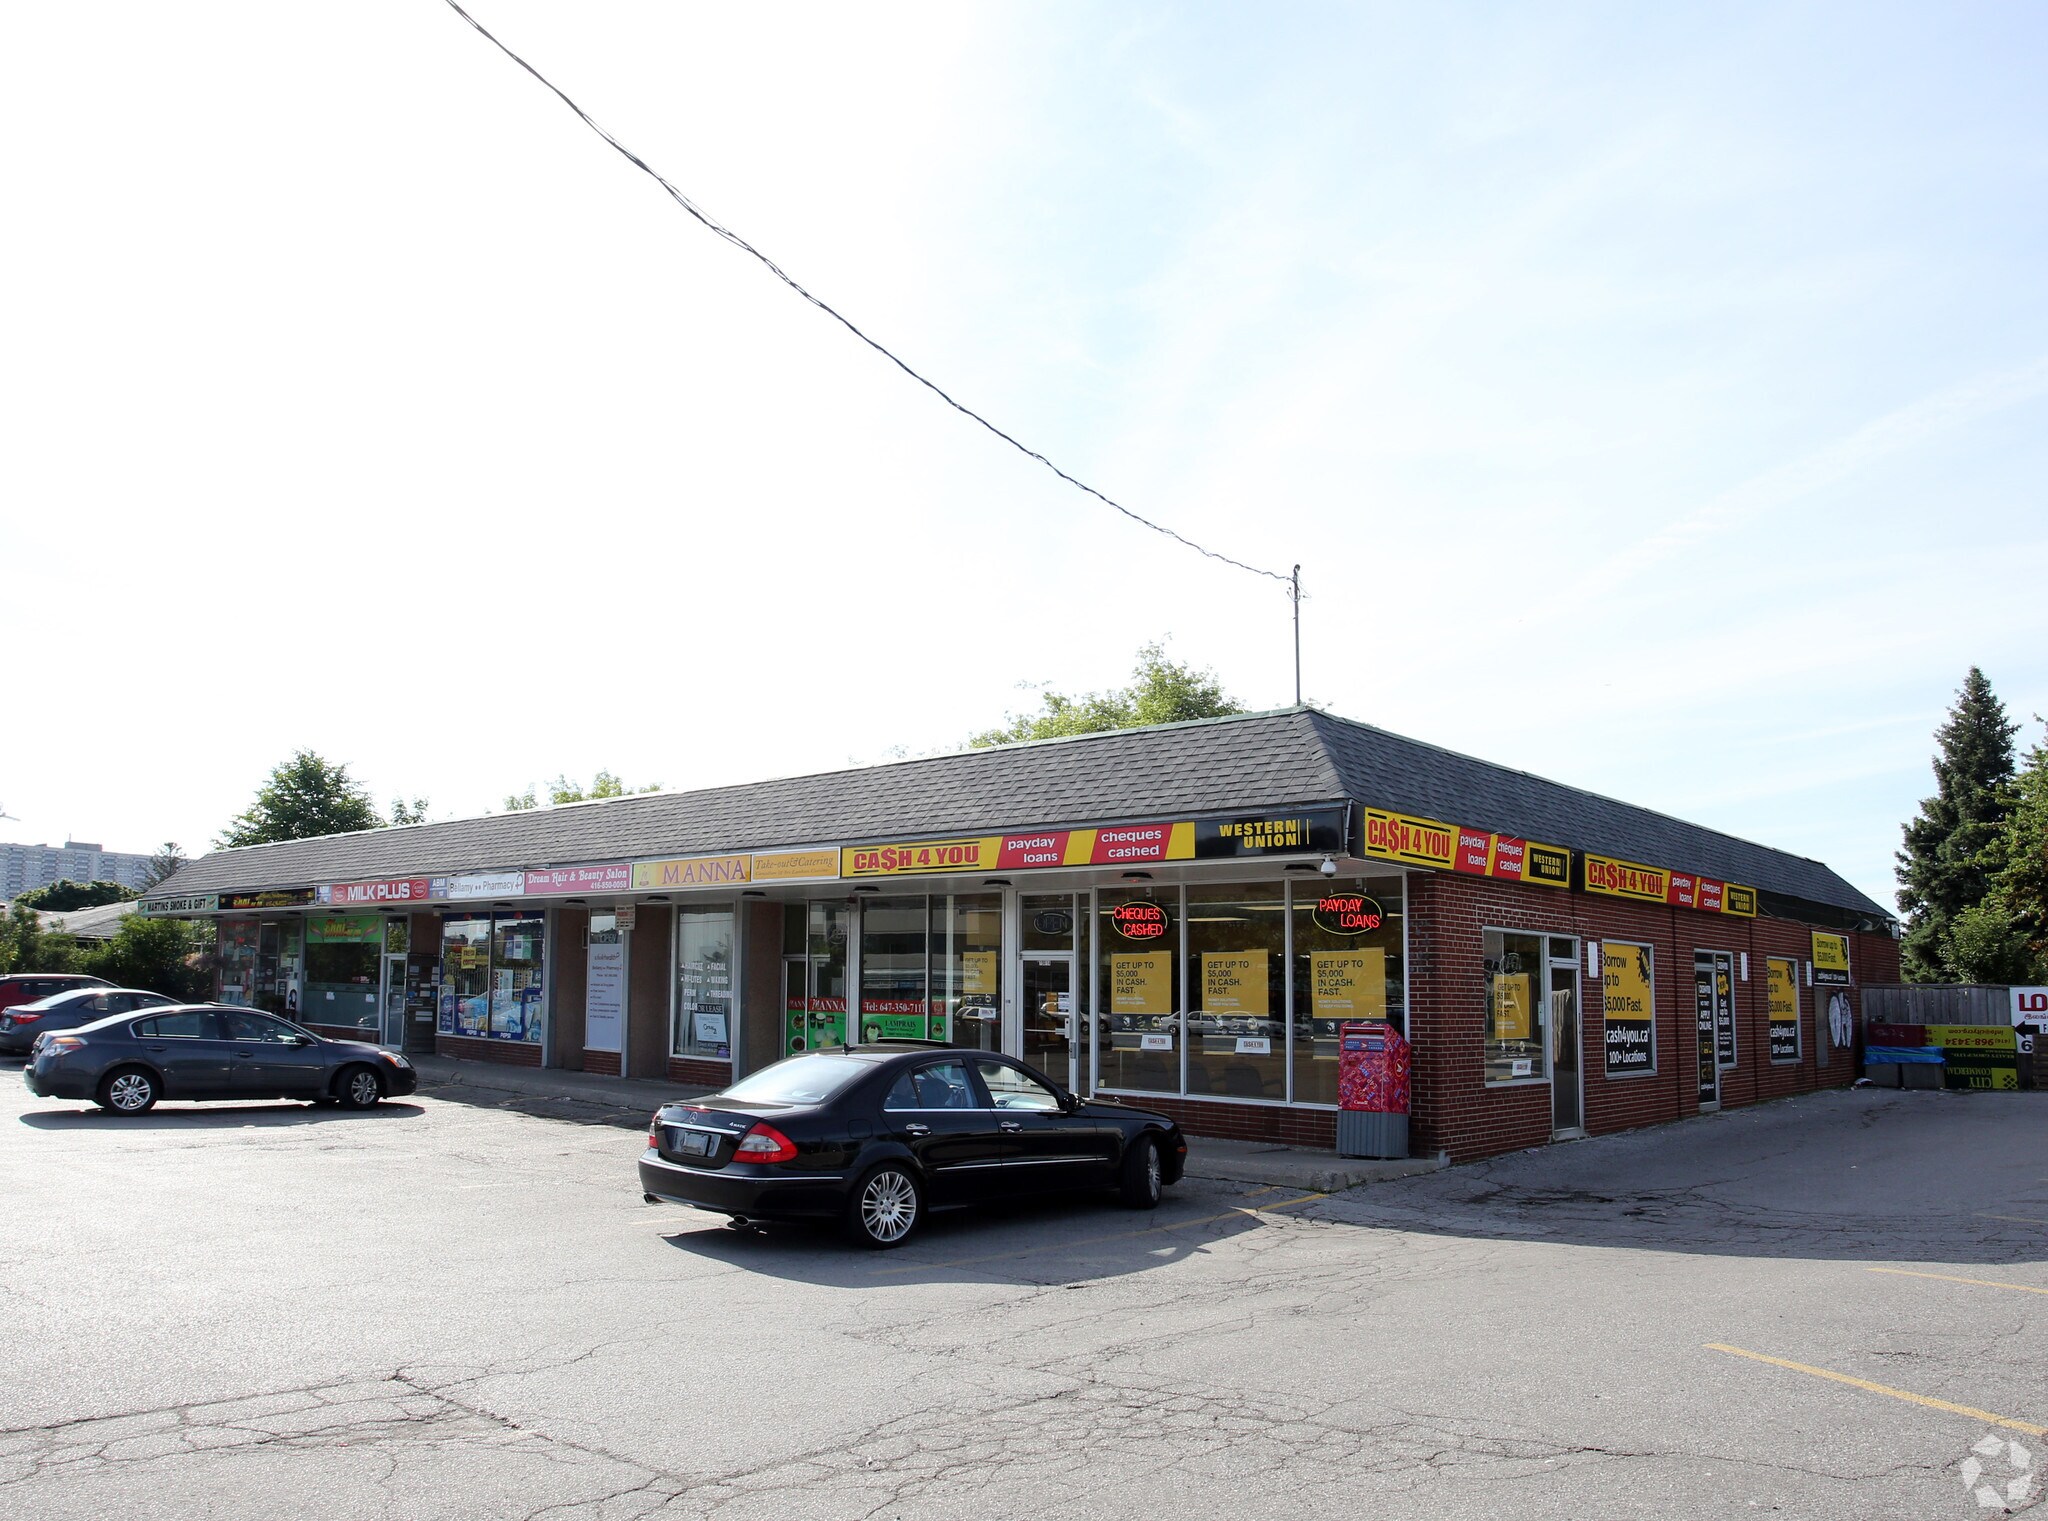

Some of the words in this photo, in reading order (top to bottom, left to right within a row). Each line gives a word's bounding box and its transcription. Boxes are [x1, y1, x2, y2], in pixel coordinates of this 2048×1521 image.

[1219, 819, 1297, 837] WESTERN
[1101, 829, 1162, 843] cheques
[1243, 833, 1297, 849] UNION
[1368, 818, 1410, 853] CA$H
[1412, 828, 1422, 852] 4
[1424, 830, 1450, 858] YOU
[1459, 835, 1485, 850] payday
[1008, 837, 1056, 850] payday
[1497, 841, 1523, 856] cheques
[1023, 851, 1058, 863] loans
[1107, 844, 1160, 858] cashed
[853, 847, 913, 871] CA$H
[916, 848, 931, 866] 4
[935, 845, 979, 864] YOU
[1467, 853, 1487, 867] loans
[1532, 853, 1561, 866] WESTERN
[662, 859, 746, 884] MANNA
[1499, 859, 1522, 873] cashed
[1541, 864, 1561, 876] UNION
[432, 878, 446, 888] ABM
[528, 873, 549, 884] Dream
[551, 871, 568, 887] Hair
[569, 871, 576, 881] &
[578, 869, 604, 882] Beauty
[605, 868, 627, 880] Salon
[1588, 863, 1626, 890] CA$H
[1629, 871, 1637, 890] 4
[1640, 873, 1663, 895] YOU
[1672, 876, 1692, 889] payday
[347, 884, 377, 901] MILK
[377, 882, 410, 900] PLUS
[450, 881, 474, 894] Bellamy
[482, 878, 515, 892] Pharmacy
[1701, 881, 1721, 895] cheques
[1679, 892, 1693, 904] loans
[1703, 897, 1720, 909] cashed
[147, 900, 169, 912] MARTINS
[170, 899, 187, 911] SMOKE
[188, 899, 193, 910] &
[194, 898, 207, 910] GIFT
[1319, 898, 1363, 912] PAYDAY
[1114, 906, 1160, 921] CHEQUES
[1036, 916, 1068, 931] OPEN
[1340, 914, 1380, 929] LOANS
[1123, 923, 1163, 936] CASHED
[710, 962, 727, 971] FACIAL
[1132, 961, 1142, 969] UP
[1144, 961, 1154, 969] TO
[1207, 961, 1223, 969] GET
[1225, 960, 1237, 969] UP
[1238, 960, 1249, 968] TO
[1317, 960, 1334, 969] GET
[1336, 960, 1349, 969] UP
[1351, 960, 1363, 968] TO
[1603, 952, 1627, 969] Borrow
[710, 975, 728, 984] WAXING
[1116, 970, 1138, 978] $5,000
[1207, 969, 1231, 978] $5,000
[1317, 969, 1344, 978] $5,000
[1116, 978, 1124, 986] IN
[1125, 978, 1147, 986] CASH.
[1207, 978, 1216, 986] IN
[1217, 978, 1242, 986] CASH.
[1317, 979, 1327, 987] IN
[1328, 978, 1355, 987] CASH.
[1612, 975, 1620, 987] to
[683, 988, 697, 997] PERM
[710, 989, 733, 999] THREADING
[1207, 987, 1230, 995] FAST.
[1317, 988, 1342, 996] FAST.
[705, 1004, 723, 1013] LEASE
[864, 1001, 878, 1012] Tel:
[1626, 997, 1643, 1012] Fast.
[1606, 1025, 1649, 1048] cash4you.ca
[1945, 1037, 1994, 1046] 968-3434
[1609, 1050, 1622, 1064] 100+
[1622, 1049, 1647, 1063] Locations
[1968, 1076, 1992, 1089] CITY
